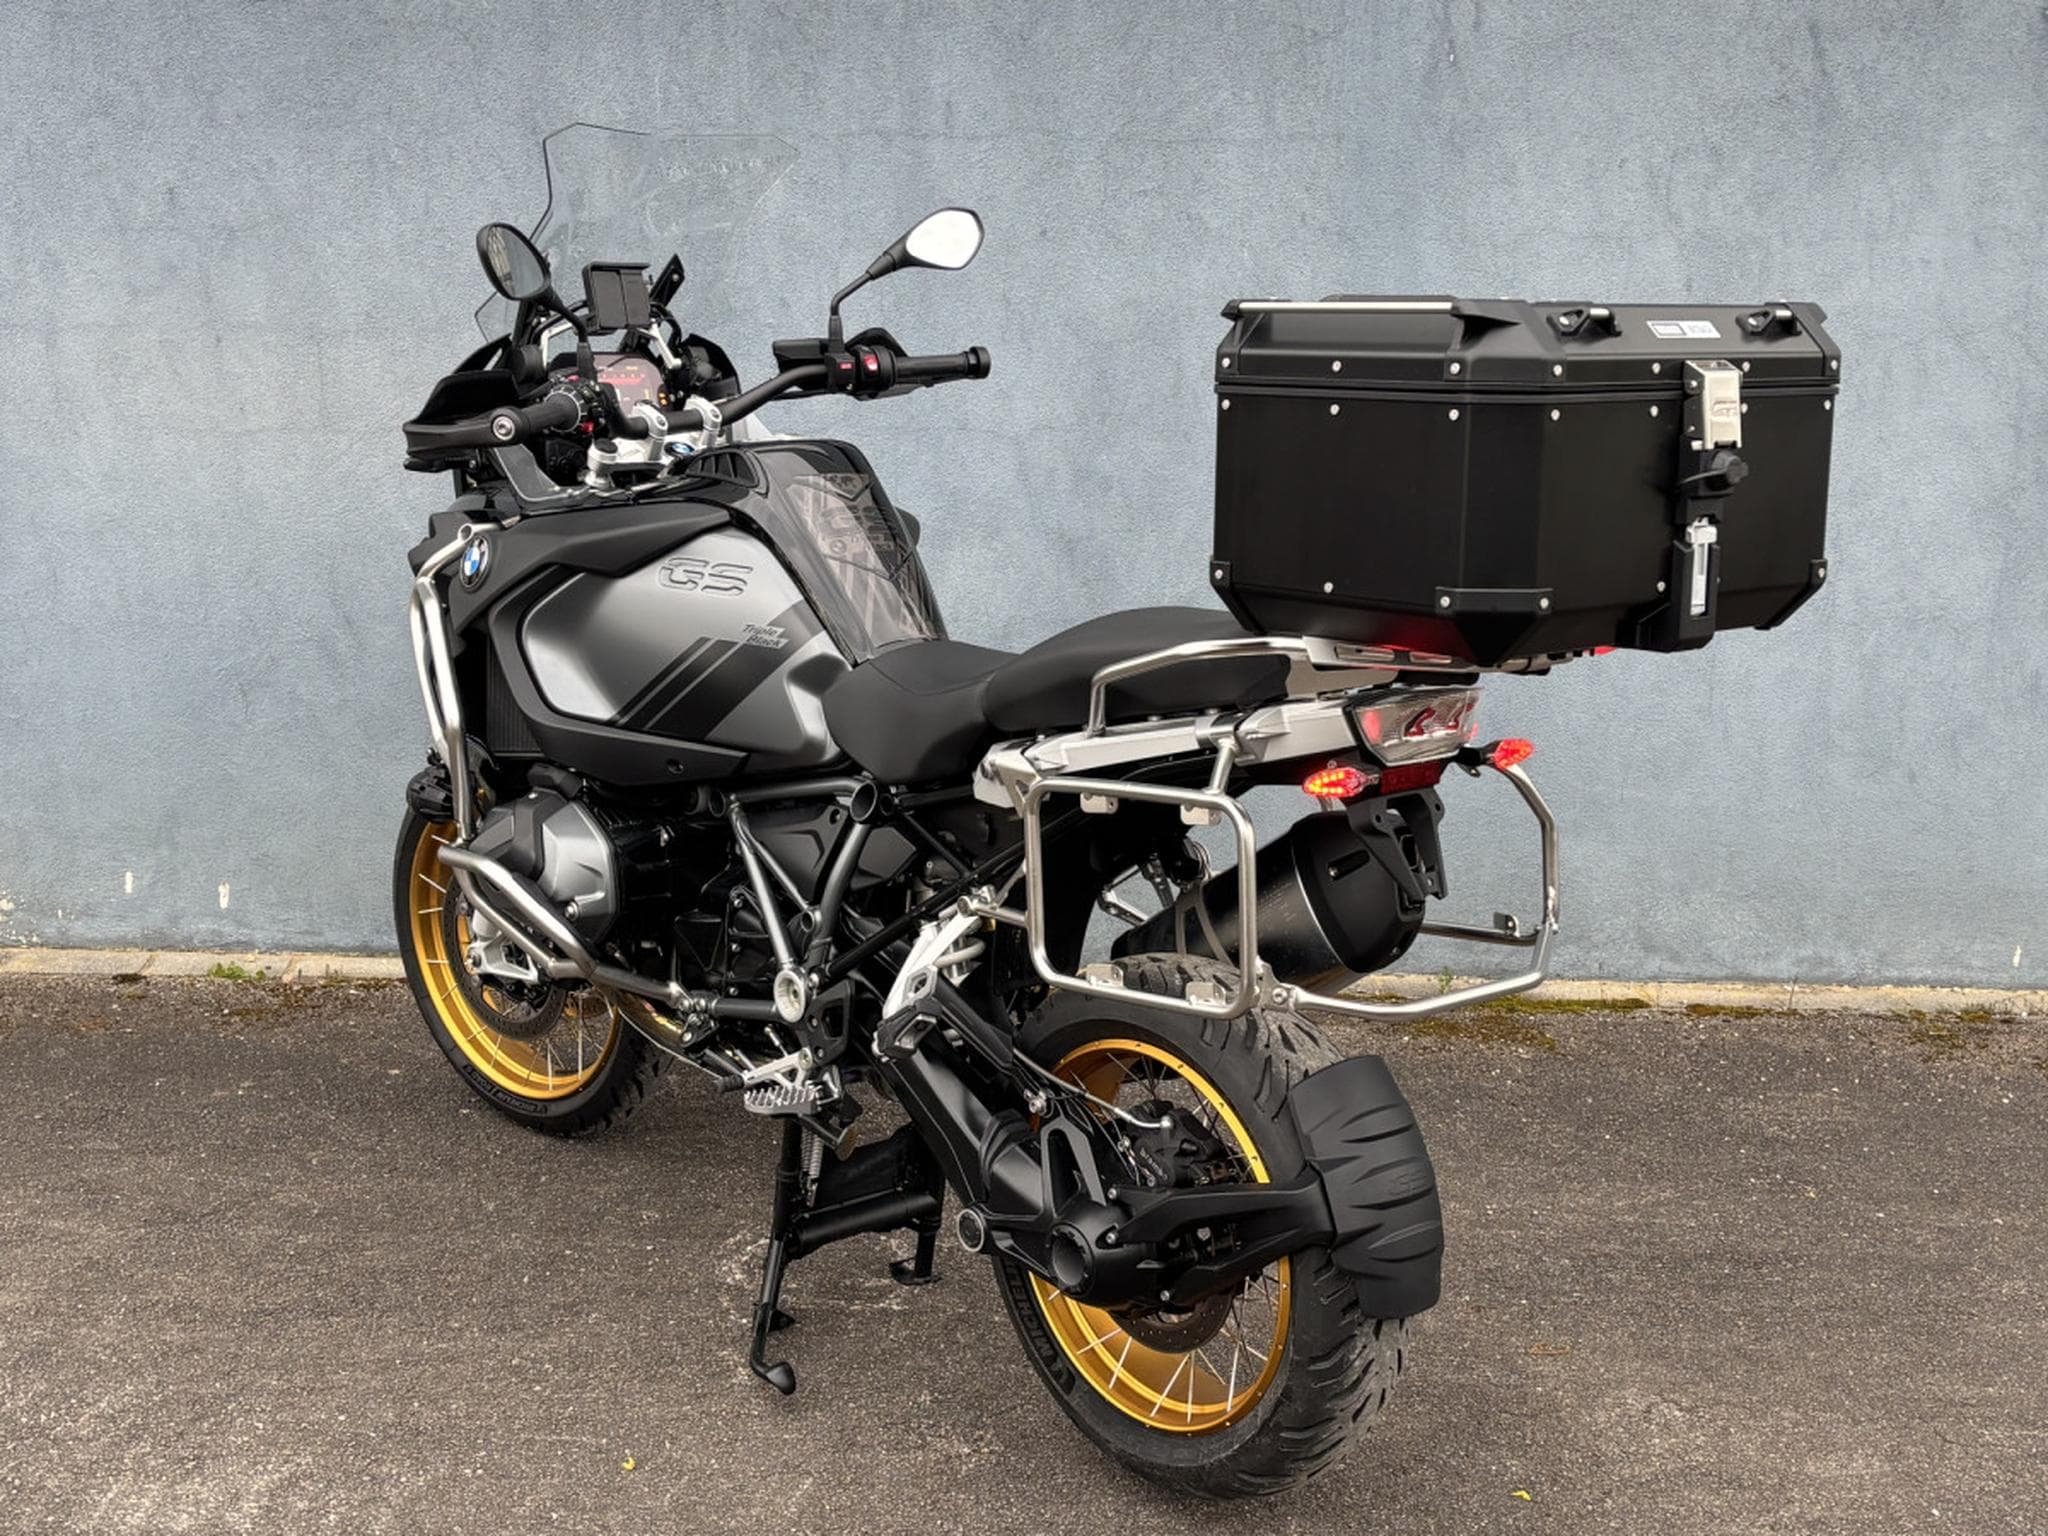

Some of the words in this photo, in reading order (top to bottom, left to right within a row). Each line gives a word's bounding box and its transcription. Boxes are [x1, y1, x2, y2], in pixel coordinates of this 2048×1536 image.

[659, 556, 753, 596] GS
[743, 623, 778, 638] Triple
[747, 634, 781, 648] Black
